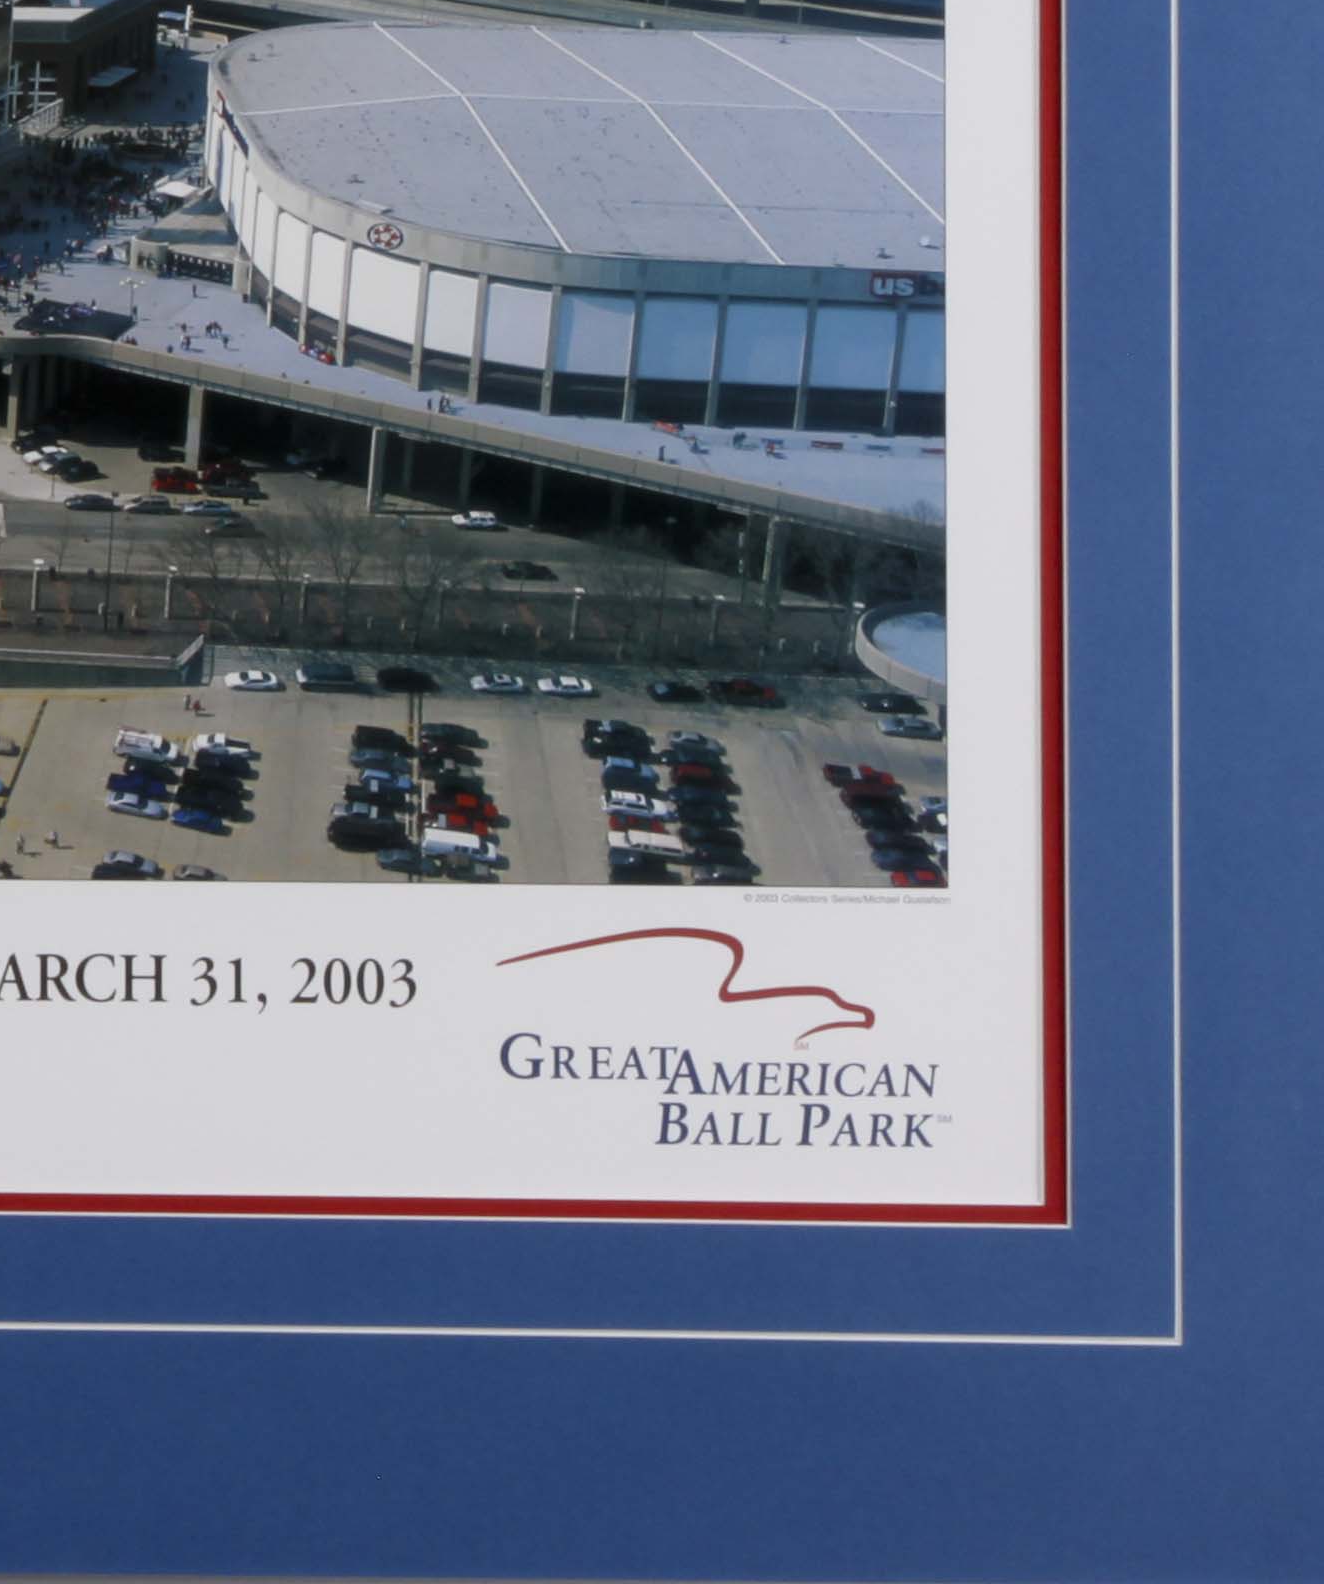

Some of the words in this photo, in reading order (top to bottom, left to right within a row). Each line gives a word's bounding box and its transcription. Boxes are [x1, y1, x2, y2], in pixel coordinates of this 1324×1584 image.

[190, 956, 267, 1011] 31,
[290, 957, 417, 1008] 2003
[655, 1102, 781, 1146] BALL
[797, 1103, 934, 1148] PARK
